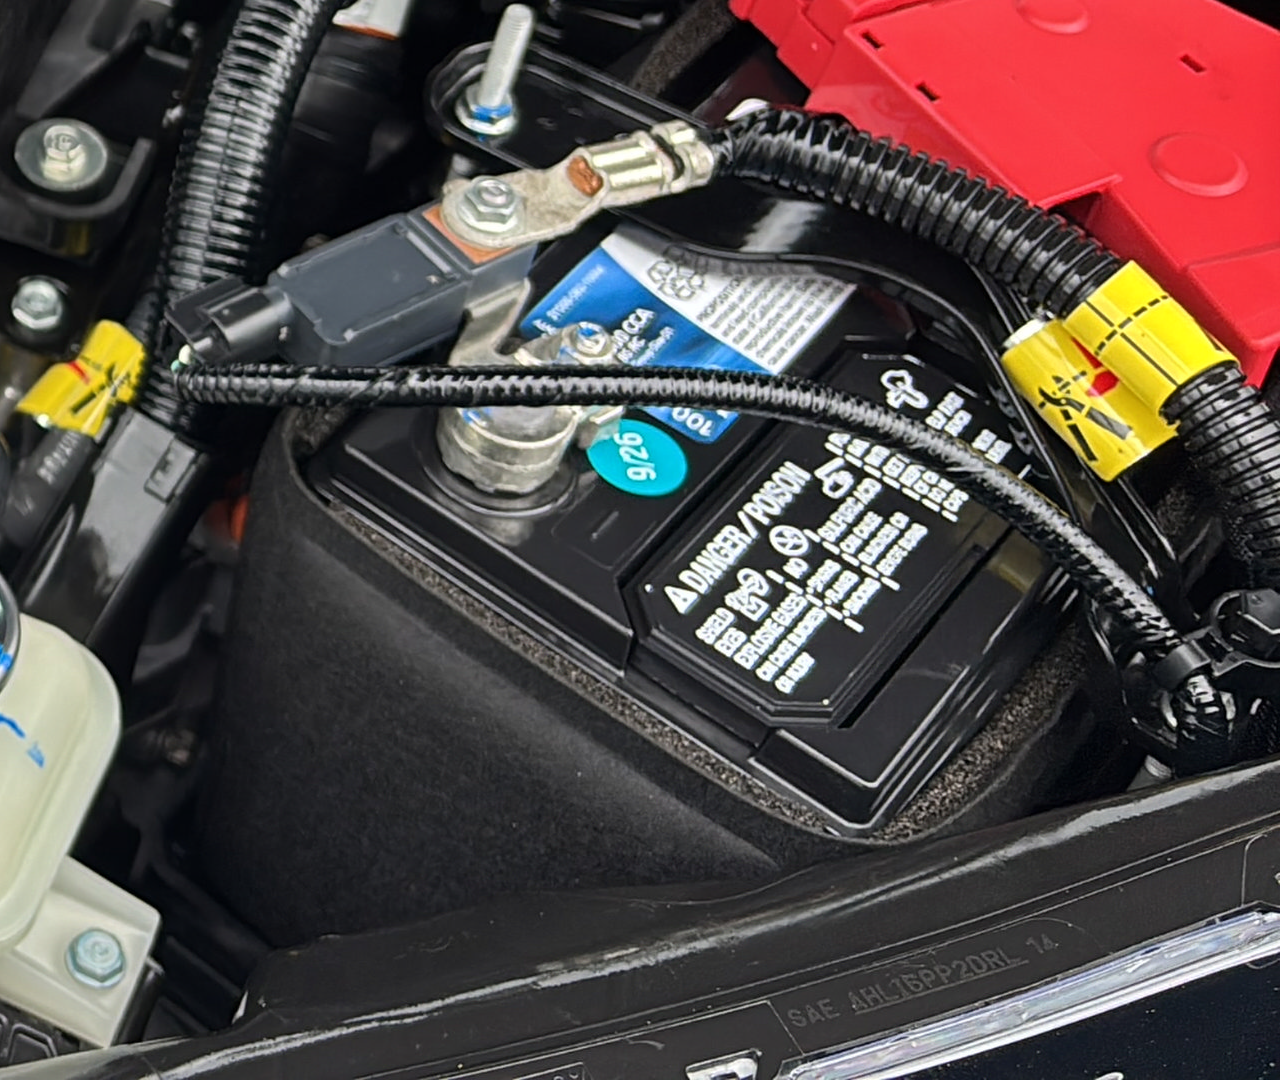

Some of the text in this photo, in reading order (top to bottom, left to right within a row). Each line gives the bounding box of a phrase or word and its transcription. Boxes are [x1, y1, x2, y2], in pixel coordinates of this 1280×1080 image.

[621, 308, 654, 341] CCA
[613, 431, 657, 481] 9/26
[678, 461, 812, 598] DANGER/POISON
[787, 997, 841, 1029] SAE
